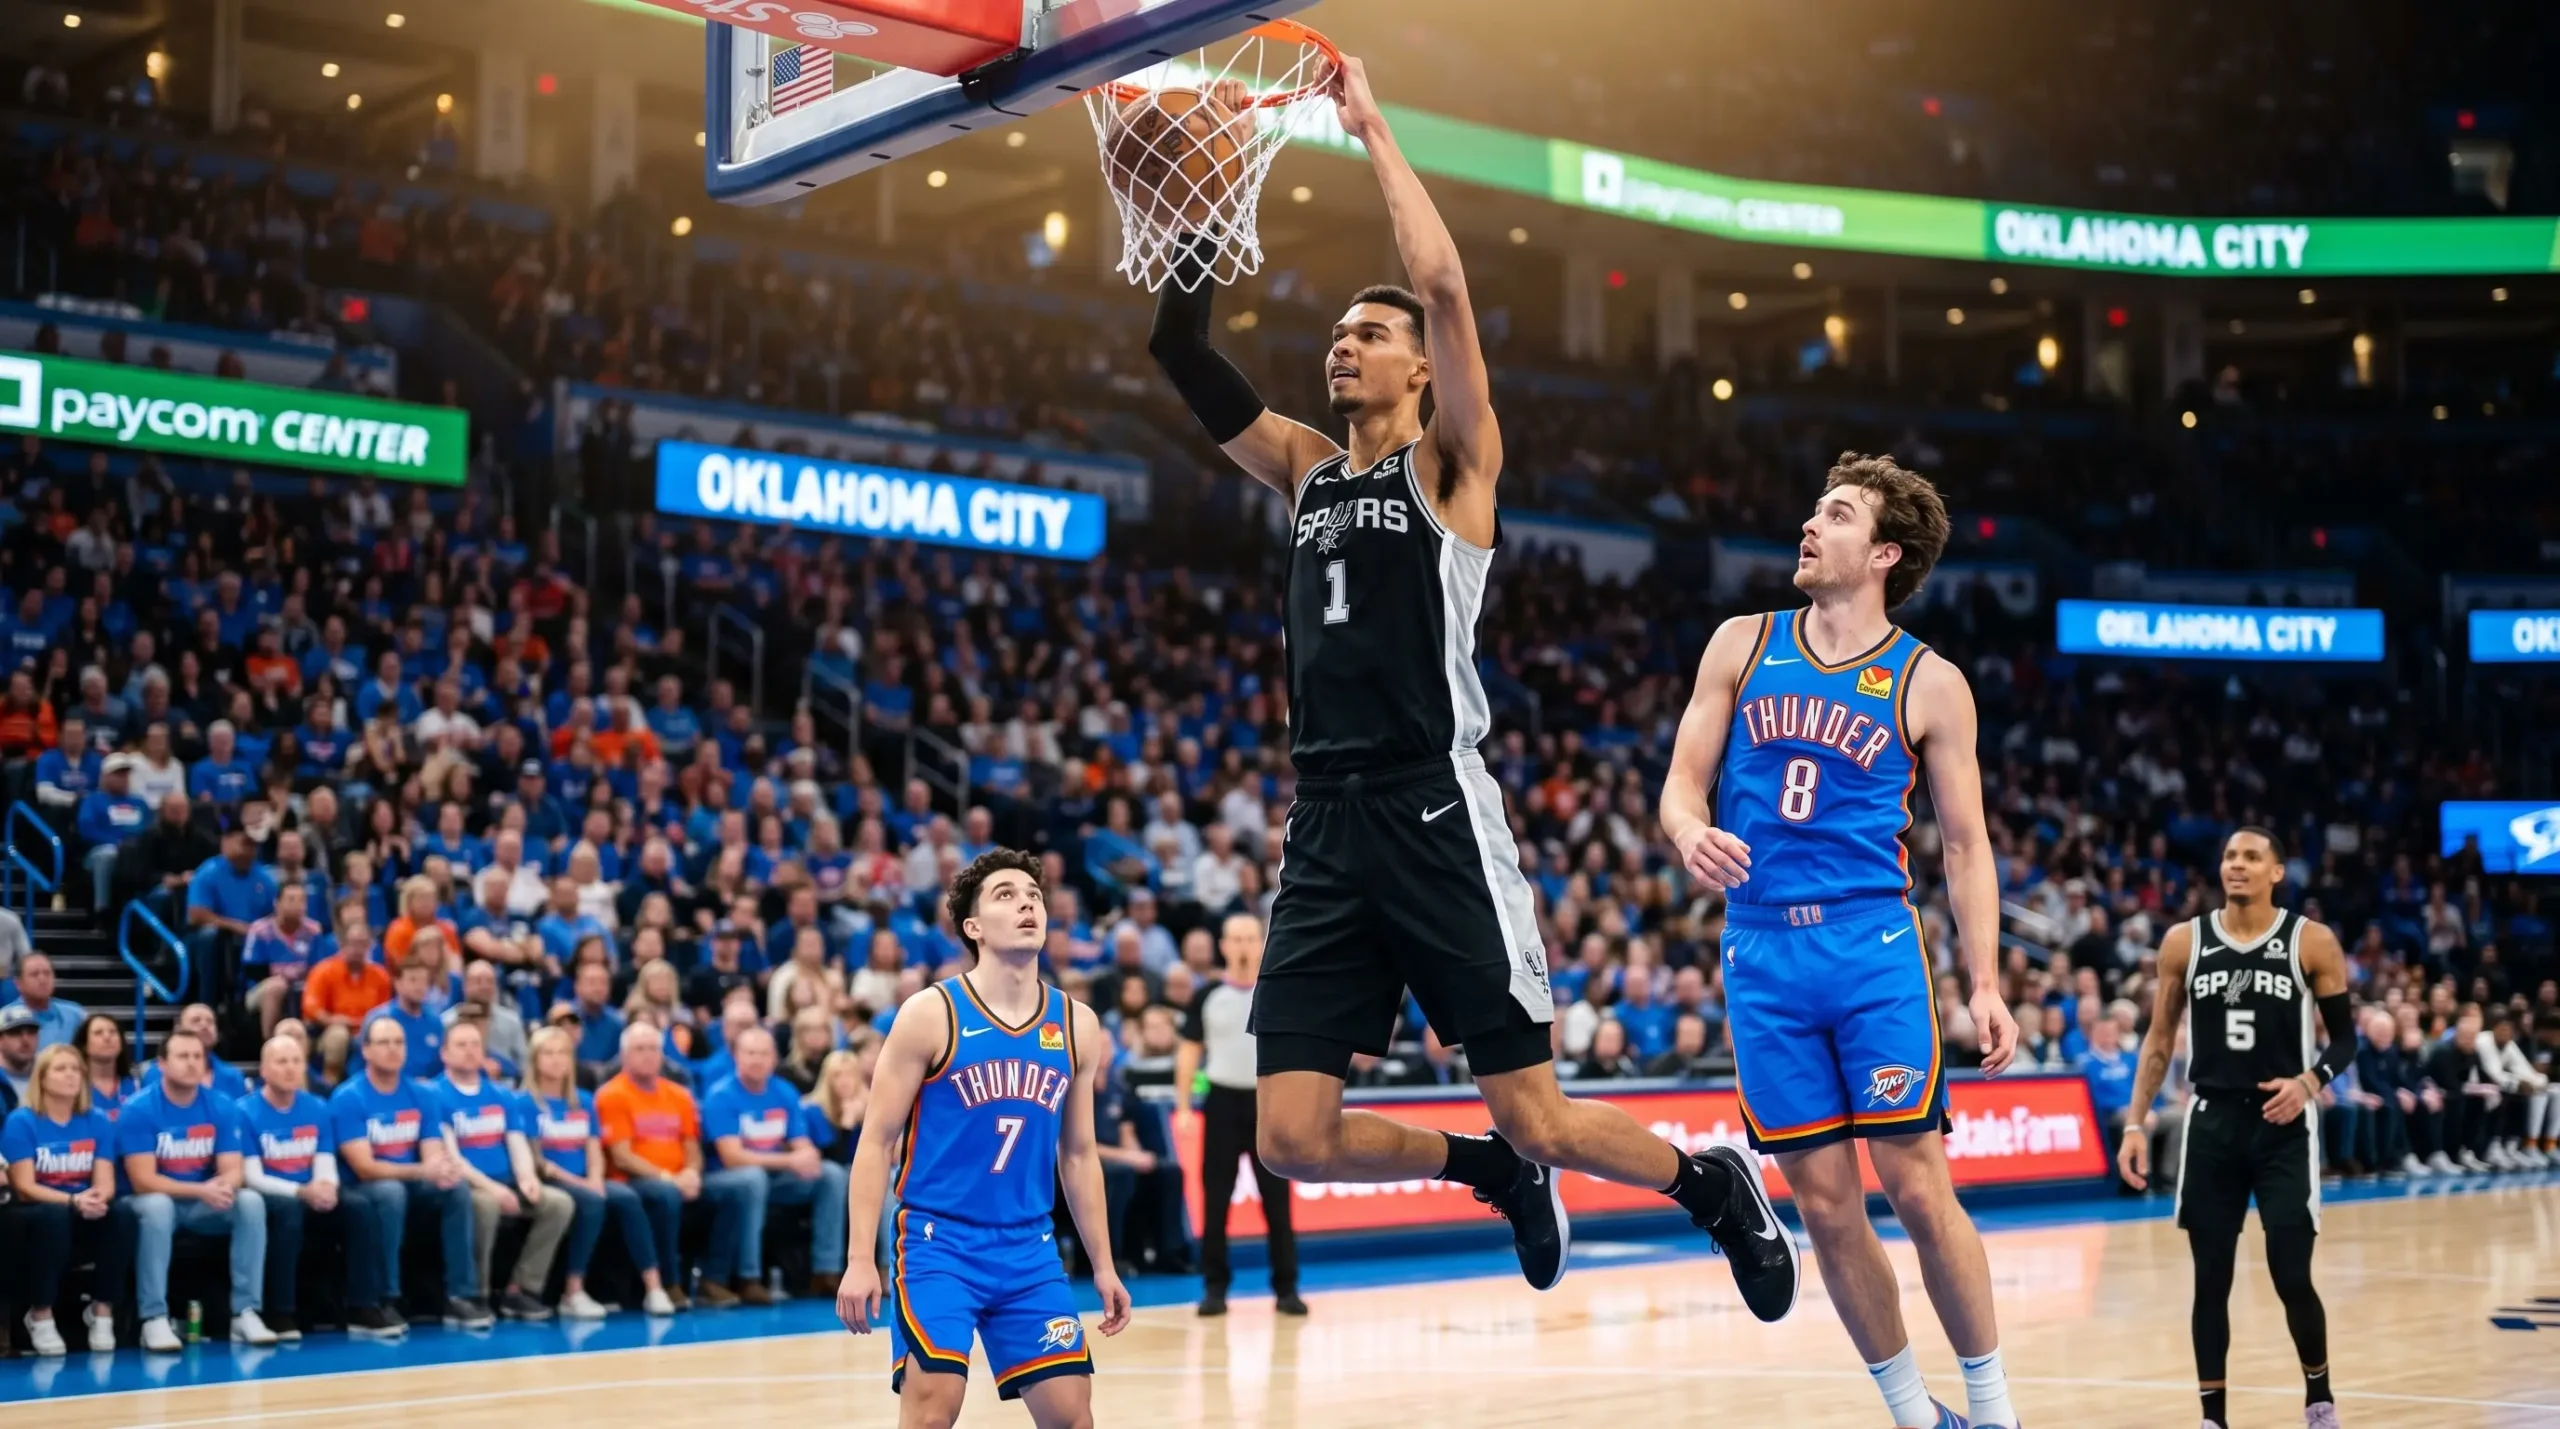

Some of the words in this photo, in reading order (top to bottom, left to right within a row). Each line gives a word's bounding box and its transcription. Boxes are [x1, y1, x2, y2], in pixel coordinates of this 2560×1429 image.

[1994, 210, 2207, 269] OKLAHOMA
[2213, 224, 2309, 269] CITY
[51, 387, 259, 442] paycom
[272, 410, 430, 467] CENTER
[697, 453, 962, 538] OKLAHOMA
[968, 487, 1071, 551] CITY
[1297, 498, 1408, 554] SPURS
[1324, 559, 1349, 625] 1
[2097, 608, 2261, 652] OKLAHOMA
[2267, 615, 2338, 653] CITY
[1742, 694, 1892, 772] THUNDER
[1779, 756, 1820, 823] 8
[2193, 969, 2293, 1005] SPURS
[2226, 1009, 2256, 1051] 5
[950, 1059, 1069, 1114] THUNDER
[1874, 1072, 1906, 1097] OKC
[991, 1116, 1026, 1173] 7
